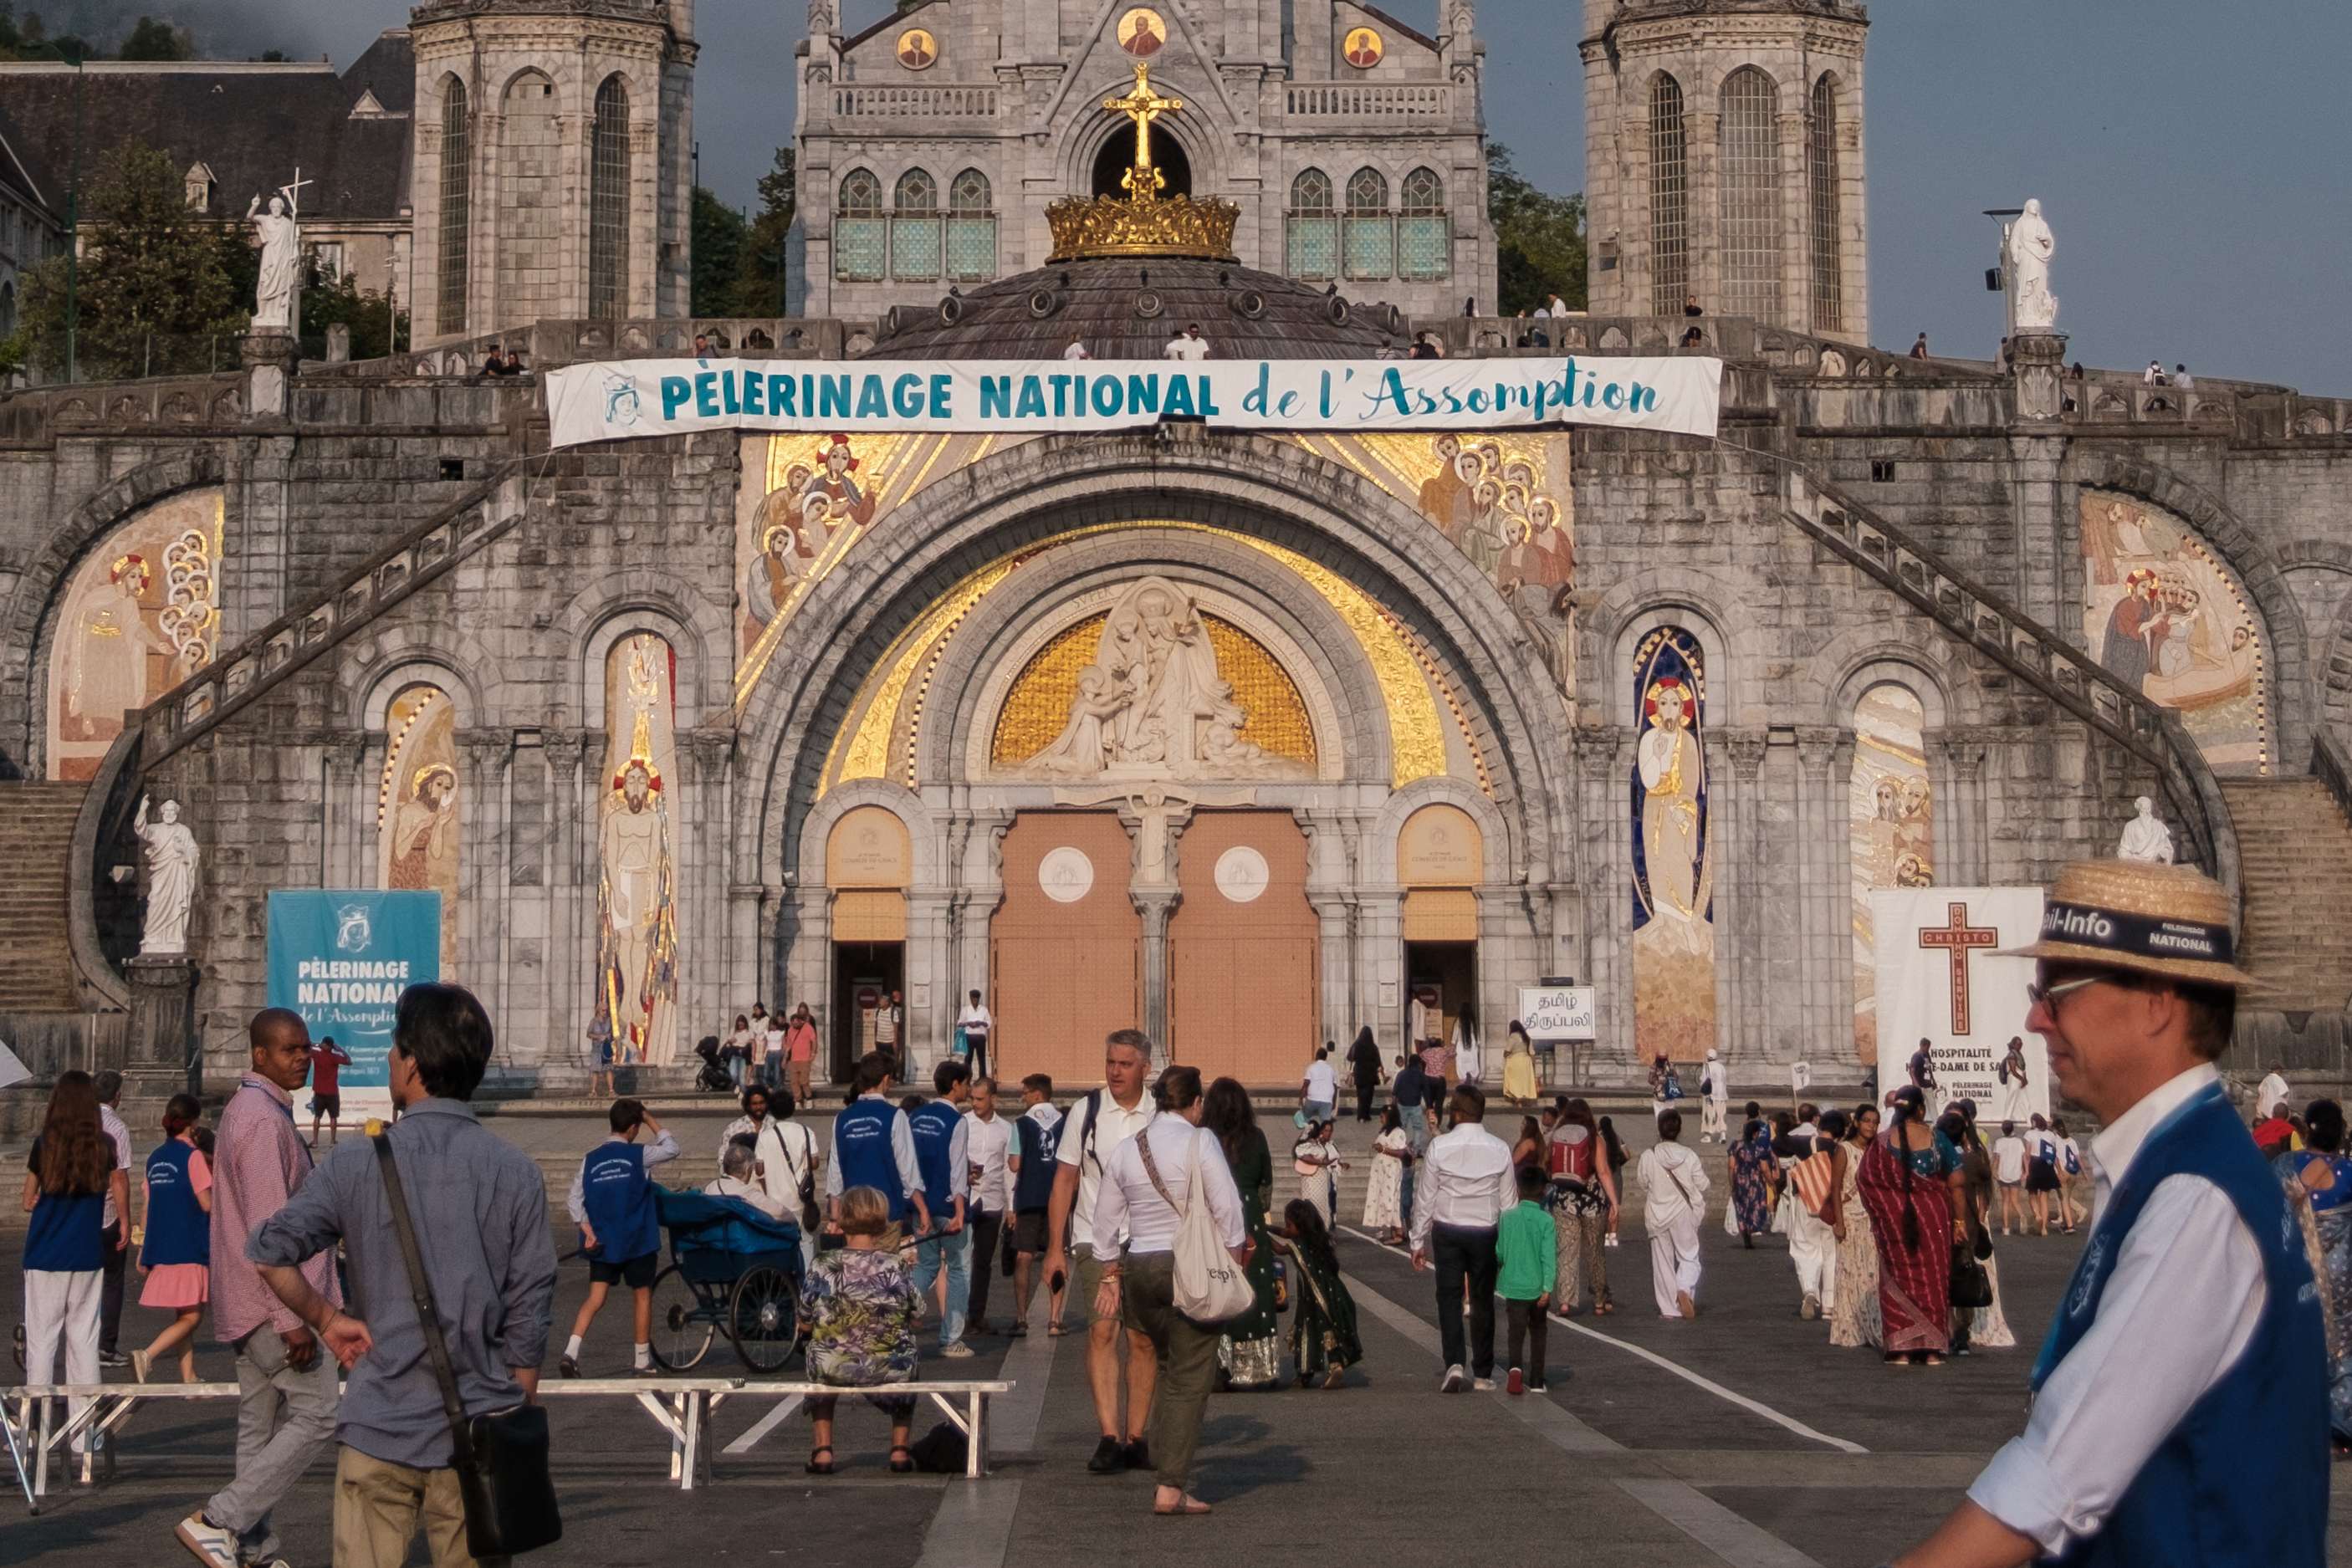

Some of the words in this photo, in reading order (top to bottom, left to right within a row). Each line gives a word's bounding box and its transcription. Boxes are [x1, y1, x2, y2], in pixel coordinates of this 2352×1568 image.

[661, 359, 953, 421] PÈLERINAGE
[980, 373, 1219, 418] NATIONAL
[1241, 361, 1306, 419] de
[1320, 355, 1664, 421] l'Assomption
[2043, 907, 2112, 937] eil-Info
[1925, 933, 1989, 942] CHRISTO
[2149, 932, 2212, 953] NATIONAL
[299, 956, 409, 978] PÈLERINAGE
[1538, 993, 1577, 1010] தமிழ்
[299, 1006, 314, 1023] de
[318, 1007, 396, 1028] l'Assomptio
[1523, 1012, 1591, 1031] திருப்பலி
[1930, 1045, 1992, 1058] HOSPITALITÉ
[1974, 1062, 1986, 1072] DE
[1952, 1090, 1992, 1098] NATIONAL
